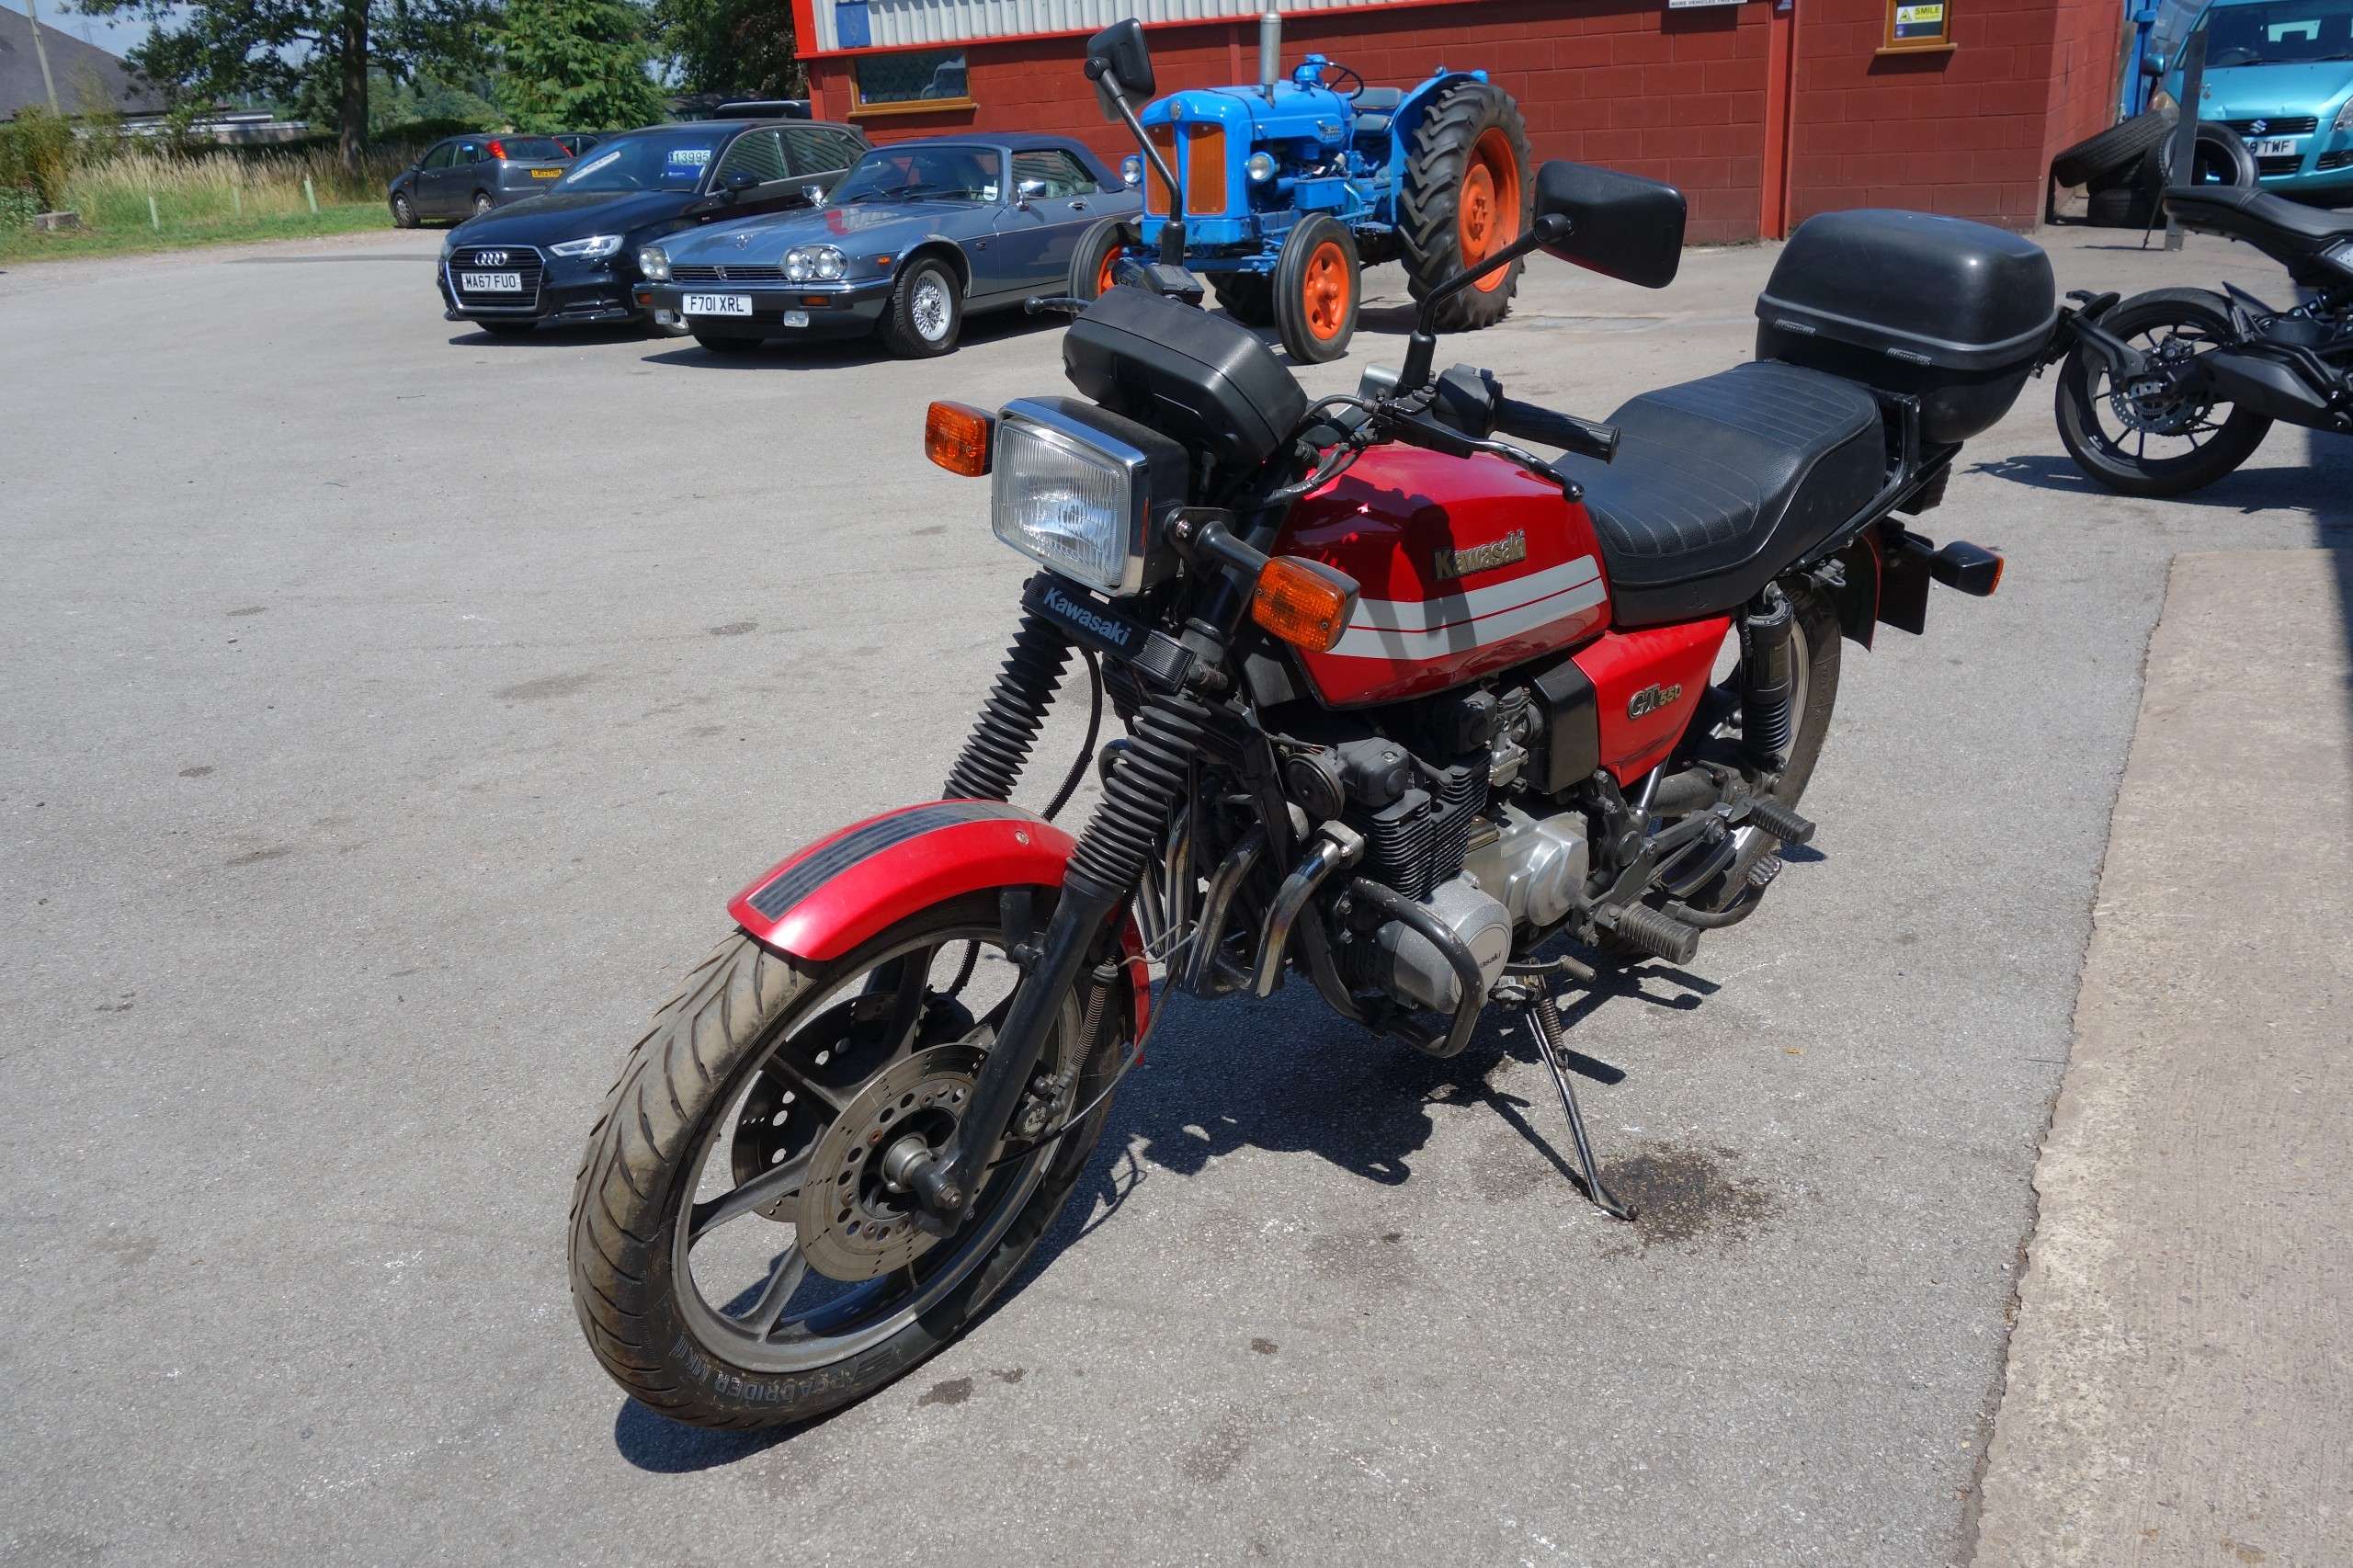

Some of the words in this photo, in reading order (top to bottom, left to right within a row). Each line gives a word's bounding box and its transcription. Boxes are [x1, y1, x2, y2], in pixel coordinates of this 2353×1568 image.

[1915, 6, 1941, 15] SMILE
[2263, 140, 2290, 153] TWF
[465, 275, 491, 288] MA67
[691, 296, 715, 312] F701
[719, 296, 744, 312] XRL
[1434, 528, 1526, 581] Kawasaki
[1043, 587, 1131, 645] Kawasaki
